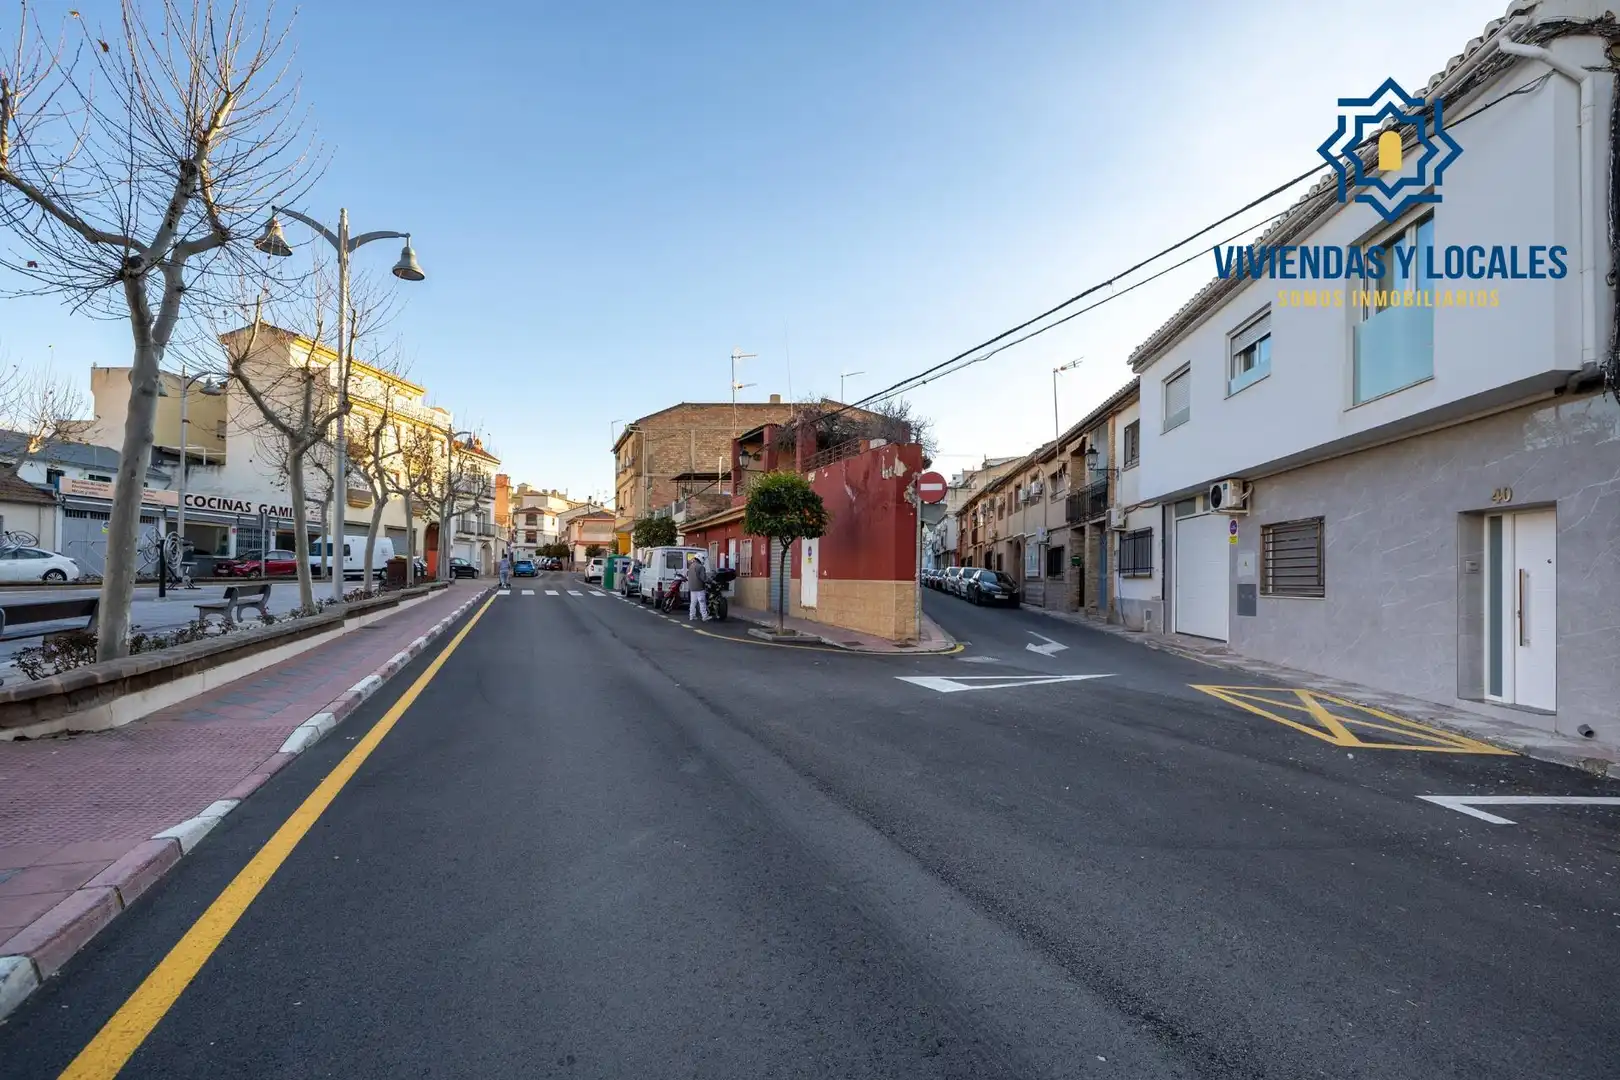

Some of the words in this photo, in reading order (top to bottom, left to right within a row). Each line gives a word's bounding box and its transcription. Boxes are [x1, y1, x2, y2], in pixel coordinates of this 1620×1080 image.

[1492, 486, 1513, 503] 40
[184, 494, 252, 513] COCINAS
[258, 503, 295, 519] GAMI
